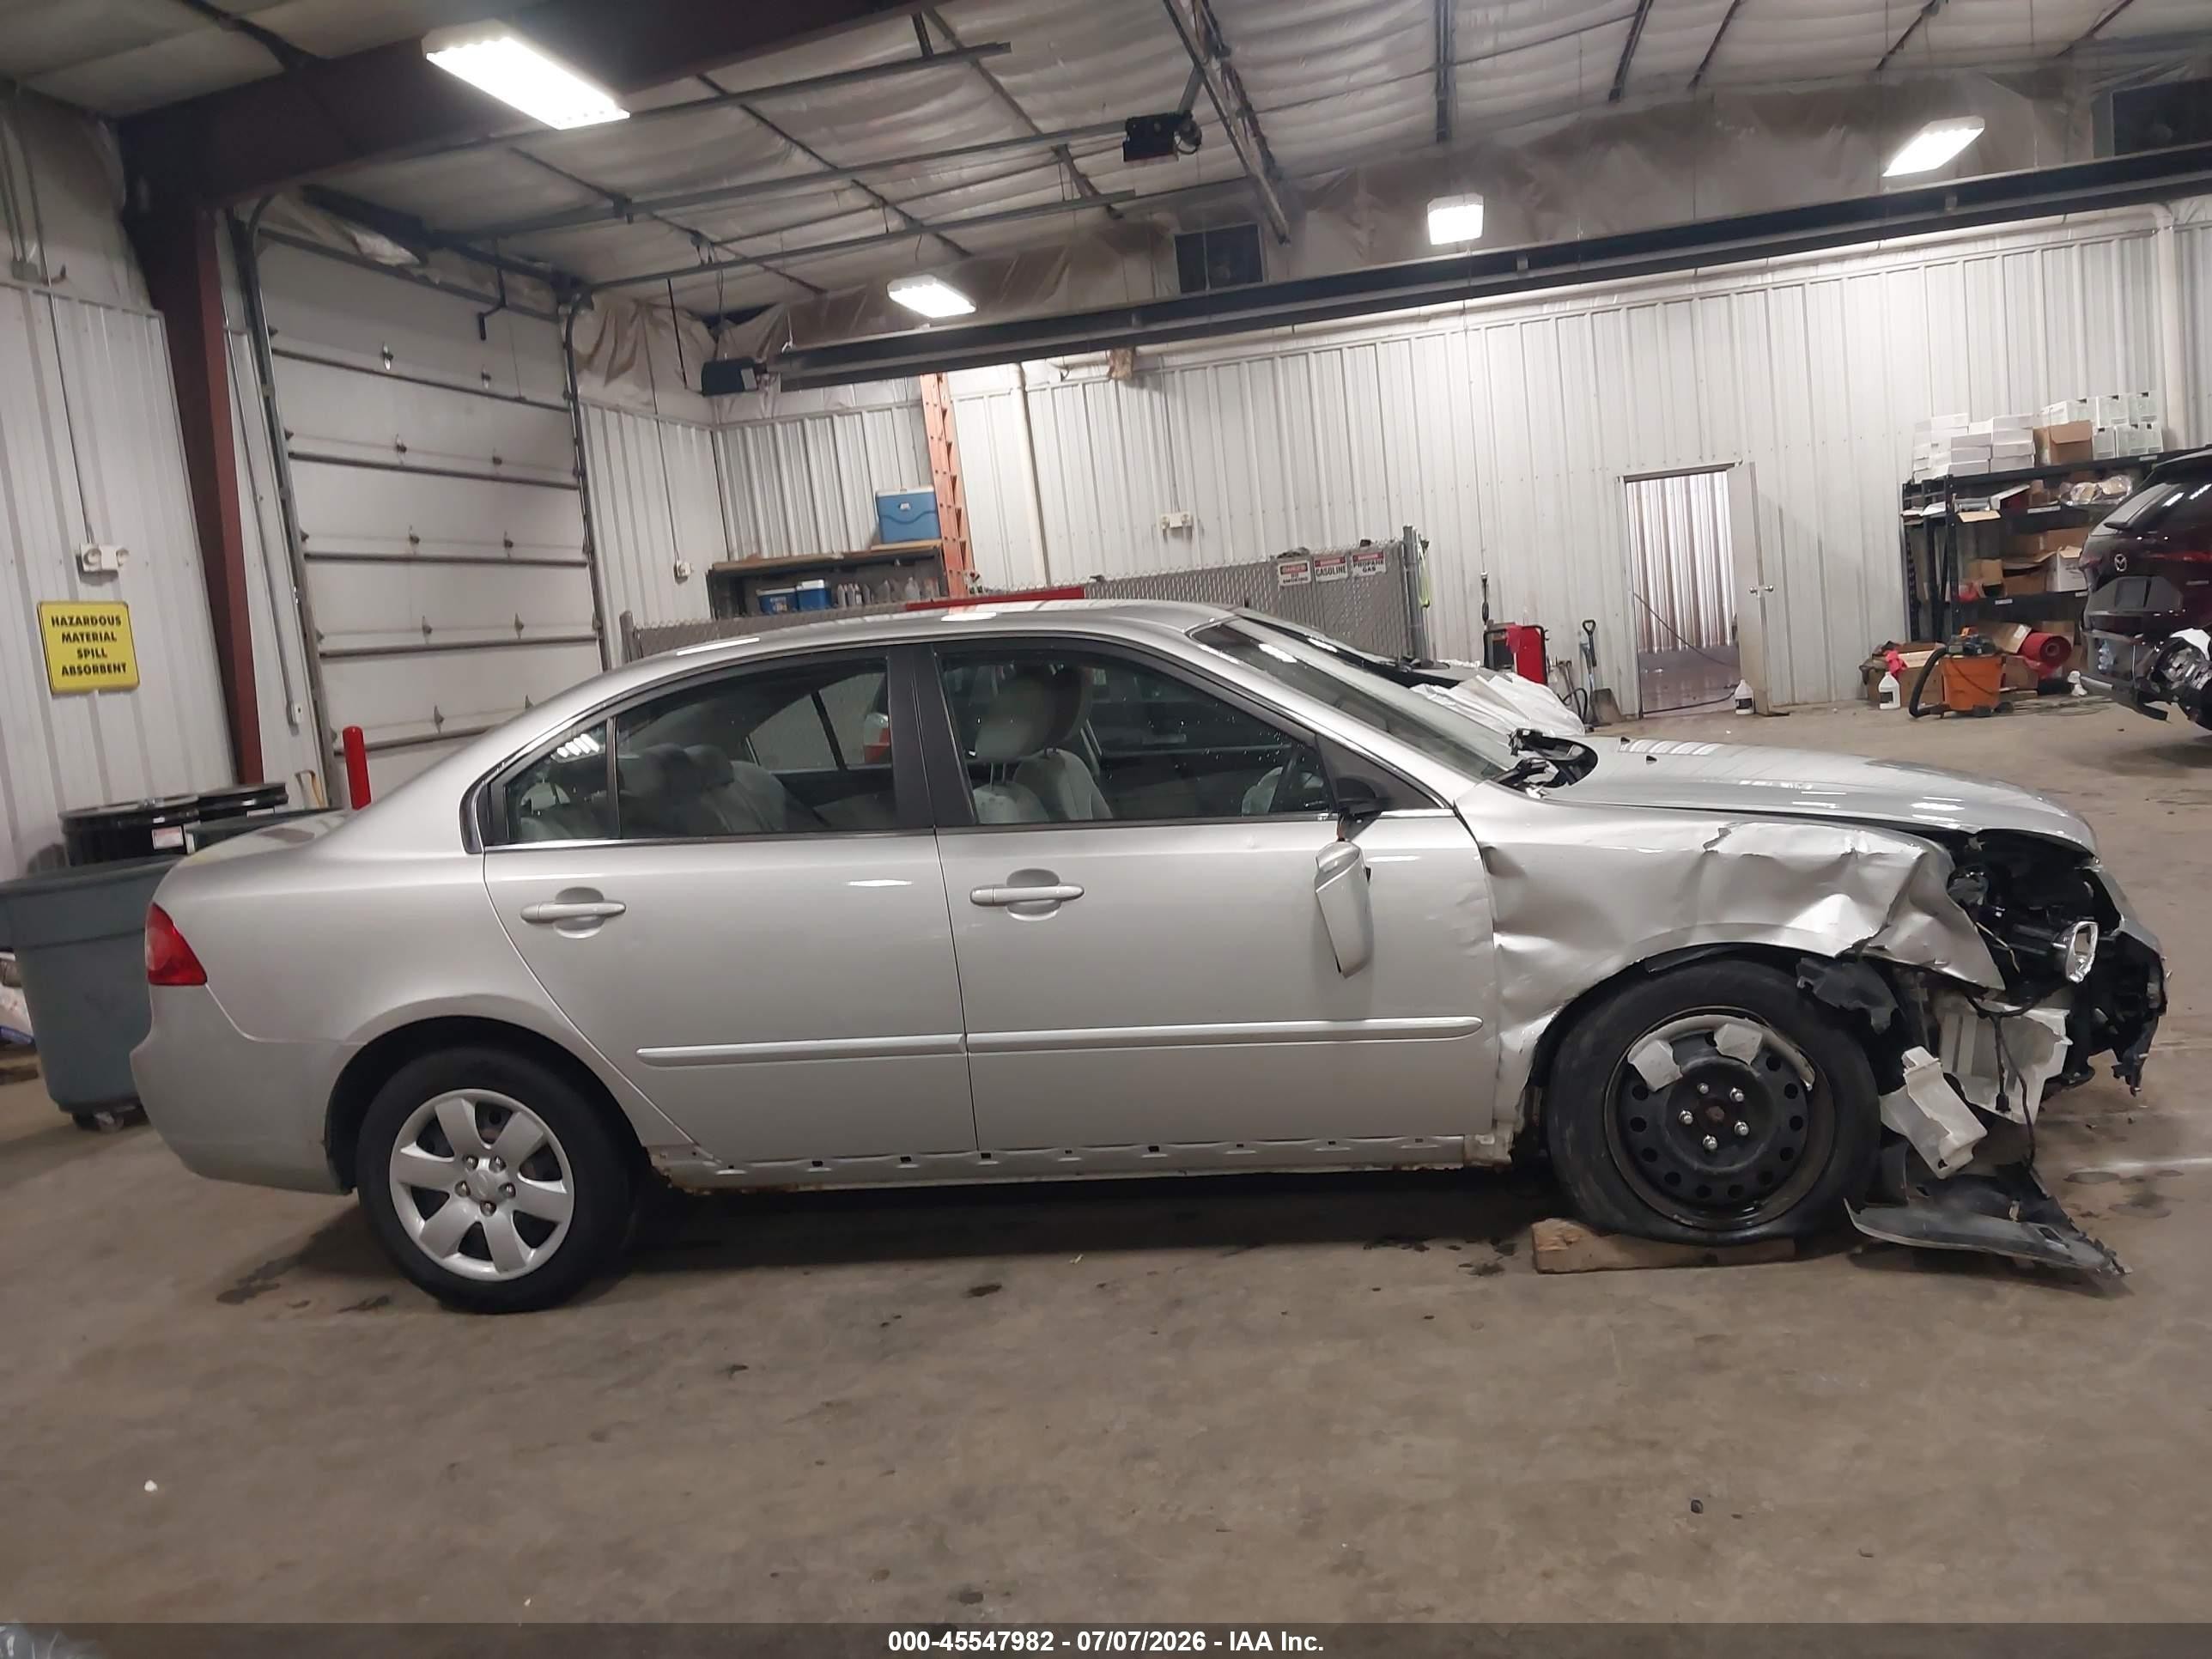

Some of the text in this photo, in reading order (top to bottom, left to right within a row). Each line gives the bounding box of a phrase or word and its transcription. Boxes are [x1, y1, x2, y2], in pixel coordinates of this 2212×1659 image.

[1316, 565, 1346, 577] GASOLINE
[51, 615, 122, 628] HAZARDOUS
[62, 631, 117, 643] MATERIAL
[76, 647, 107, 659] SPILL
[62, 663, 126, 677] ABSORBENT
